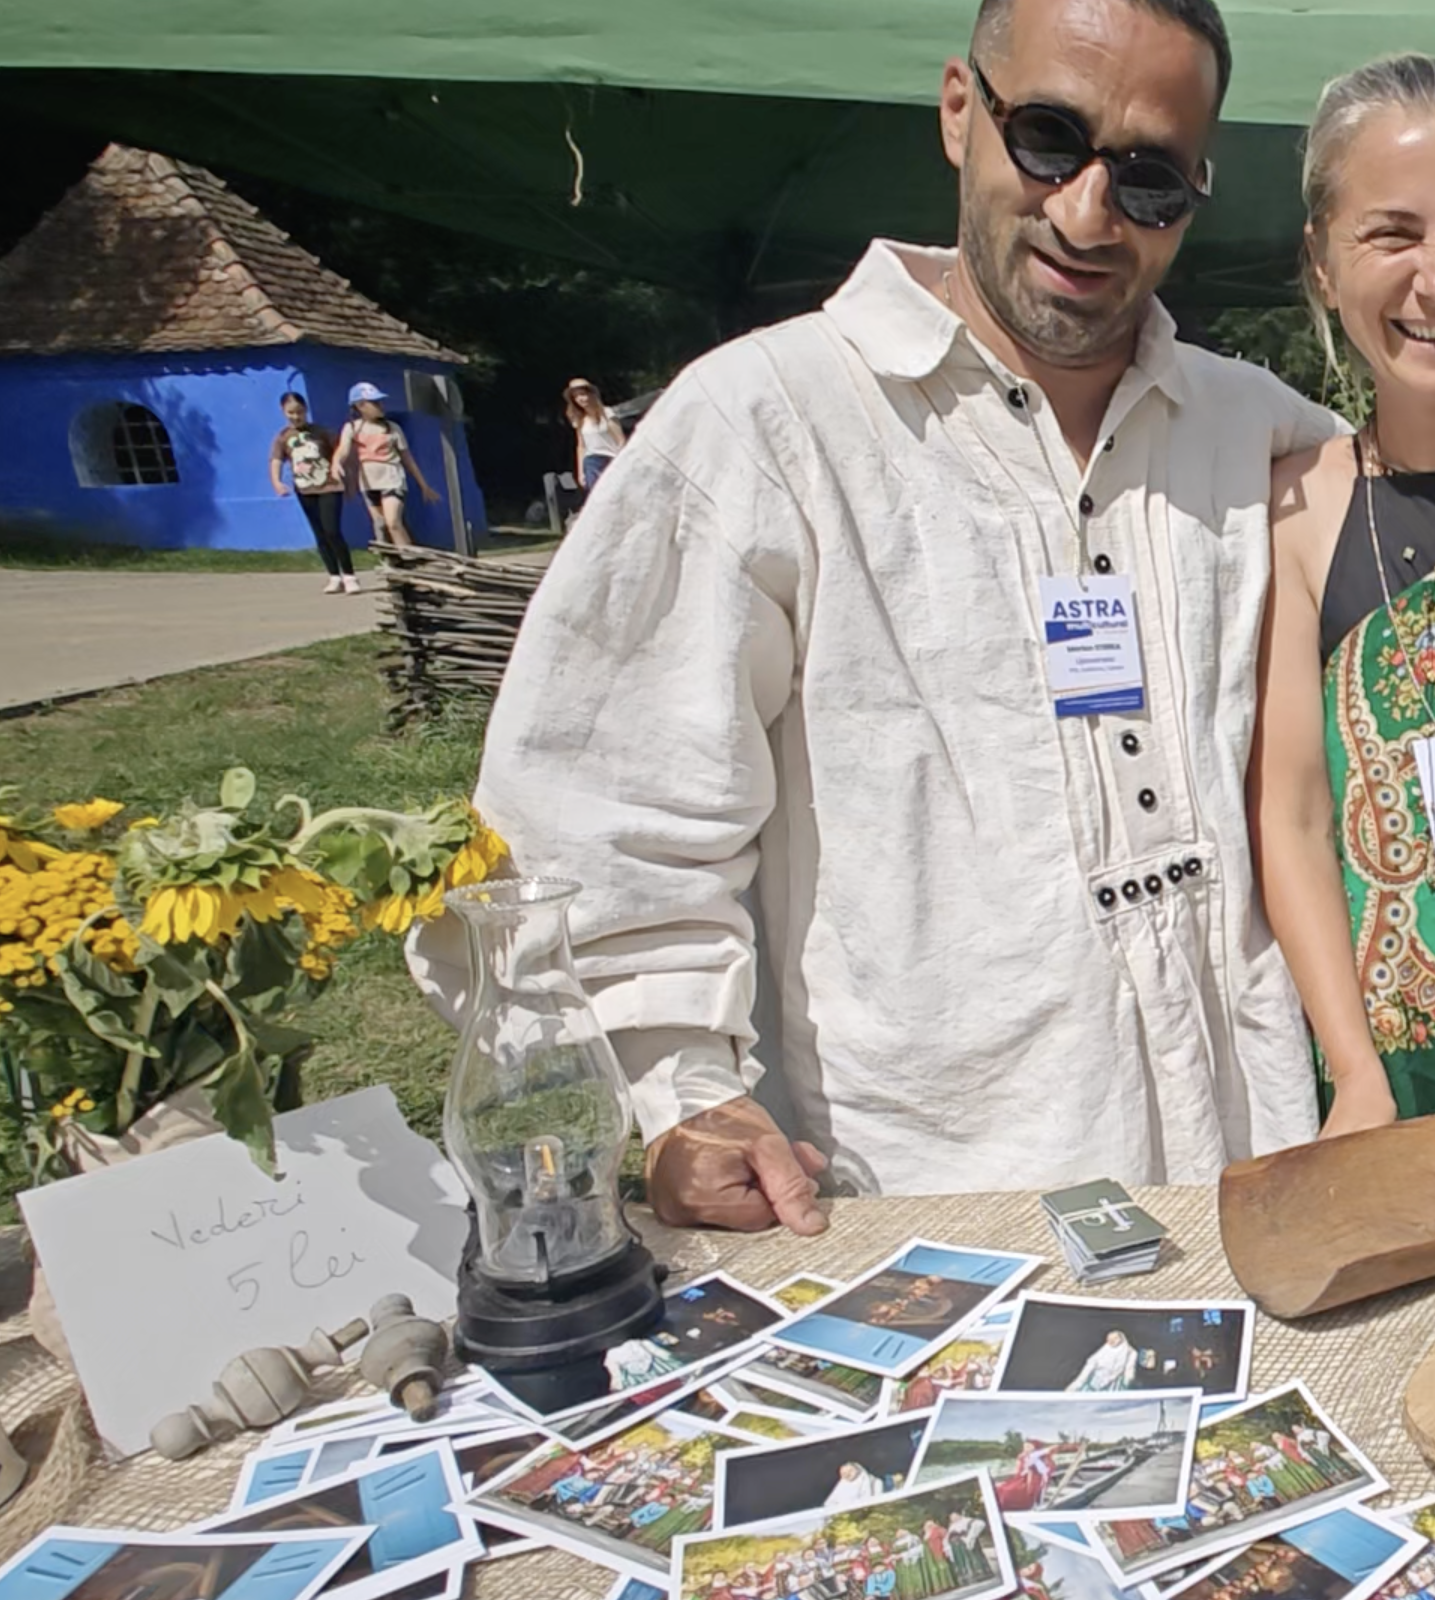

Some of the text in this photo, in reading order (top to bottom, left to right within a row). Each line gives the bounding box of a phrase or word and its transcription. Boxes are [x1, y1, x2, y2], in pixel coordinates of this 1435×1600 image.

[1052, 598, 1127, 619] ASTRA
[150, 1180, 306, 1251] Vederi
[226, 1227, 367, 1312] 5 lei
